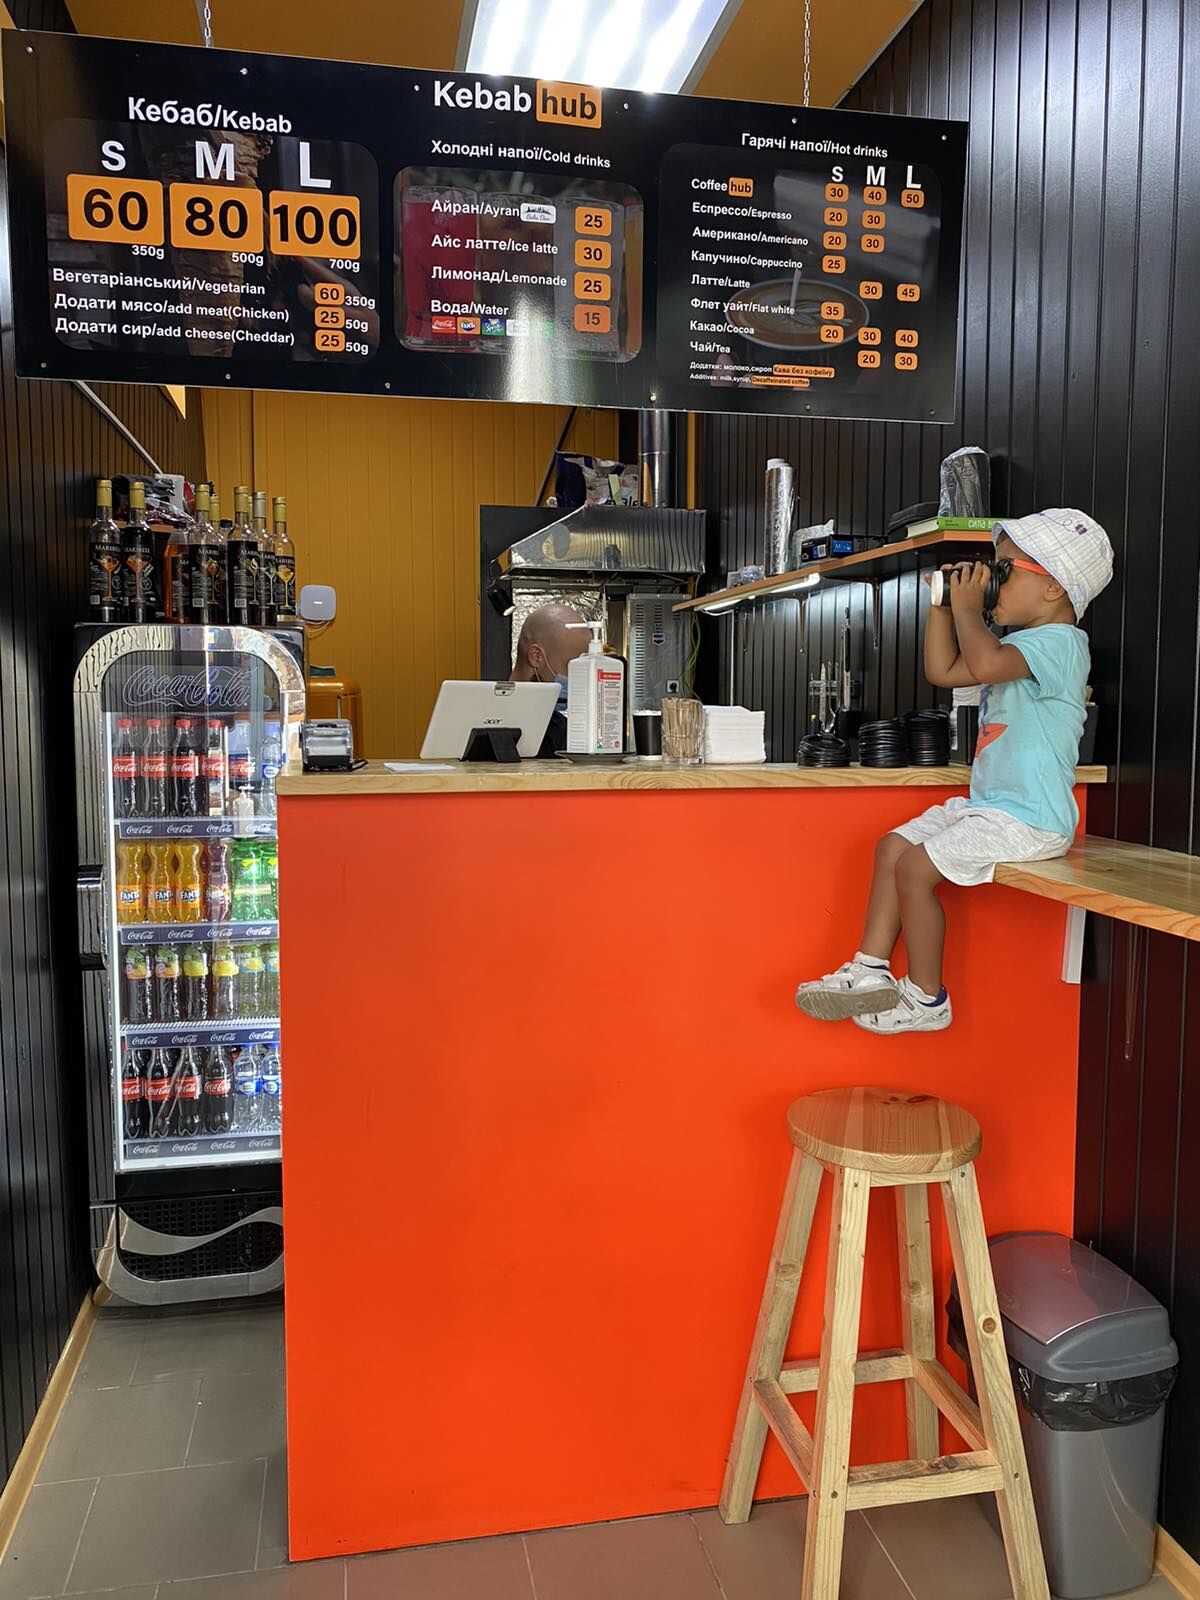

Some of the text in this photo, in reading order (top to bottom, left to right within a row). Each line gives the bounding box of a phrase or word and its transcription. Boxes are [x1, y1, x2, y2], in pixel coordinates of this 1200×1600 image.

[433, 80, 597, 120] Kebab hub
[128, 96, 292, 134] Кебаб/Kebab
[431, 140, 611, 168] Холодні напої/Cold drinks
[741, 132, 888, 158] Гарячі напої/Hot drinks
[101, 140, 331, 189] S M L
[831, 165, 922, 188] S M L
[691, 178, 919, 204] Coffee hub 30 40 50
[83, 188, 357, 247] 60 80 100
[431, 199, 520, 217] Айран/Ayran
[584, 214, 603, 228] 25
[692, 202, 880, 225] Еспрессо/Espresso 20 30
[431, 234, 602, 261] Айс латте/Ice latte 30
[692, 226, 879, 249] Американо/Americano 20 30
[131, 245, 360, 273] 350g 500g 700g
[691, 250, 841, 270] Капучино/Cappuccino 25
[52, 268, 375, 310] Вегетаріанський/Vegetarian 60 350g
[431, 266, 602, 294] Лимонад/Lemonade 25
[691, 274, 915, 298] Латте/Latte 30 45
[54, 293, 369, 332] Додати мясо/add meat(Chicken) 25 50g
[431, 299, 601, 325] Вода/Water 15
[690, 297, 839, 316] Флет уайт/Flat white 35
[55, 317, 369, 355] Додати сир/add cheese(Cheddar) 25 50g
[690, 320, 913, 344] Какао/Cocoa 20 30 40
[690, 340, 912, 367] Чай/Tea 20 30
